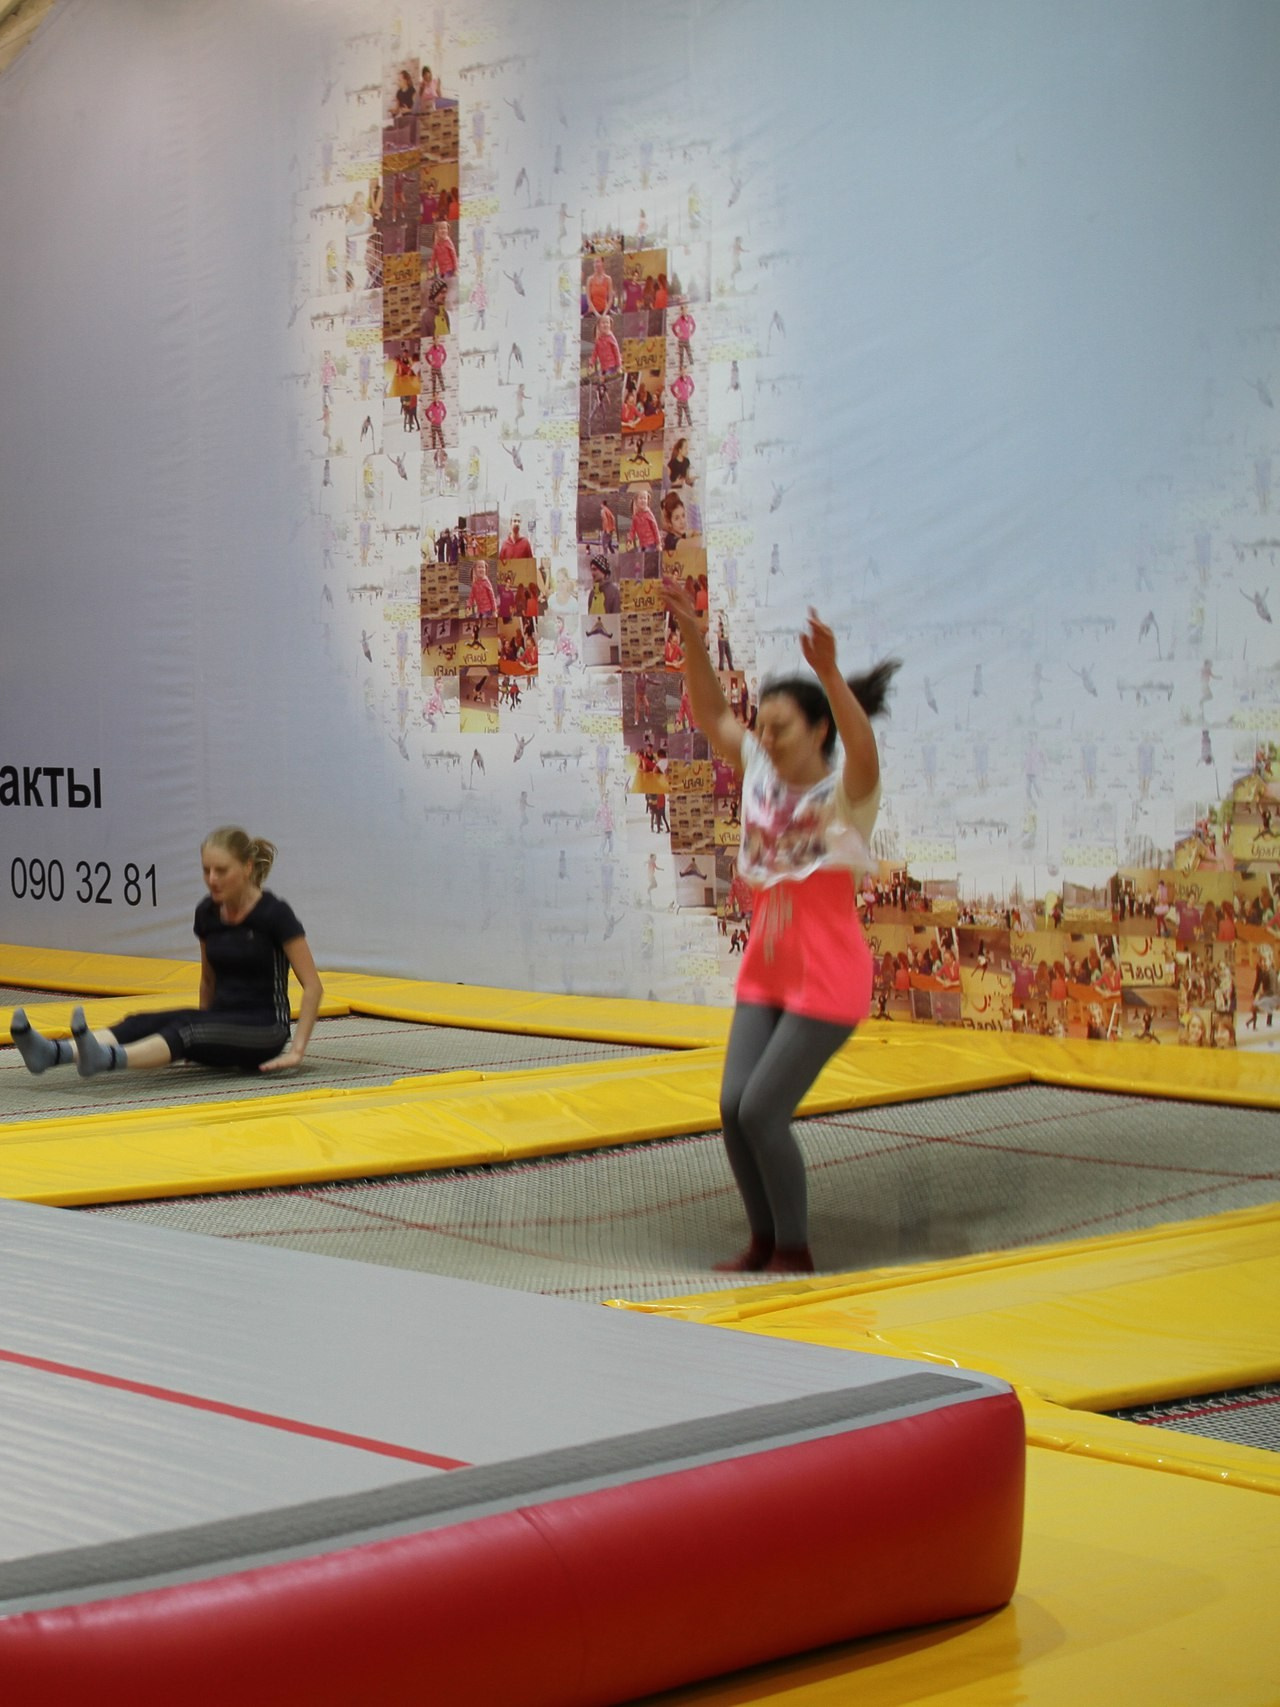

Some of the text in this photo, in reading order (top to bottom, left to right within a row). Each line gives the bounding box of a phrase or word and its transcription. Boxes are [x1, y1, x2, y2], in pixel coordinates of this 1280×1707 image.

[11, 857, 64, 902] 090
[76, 861, 112, 904] 32
[124, 863, 157, 907] 81
